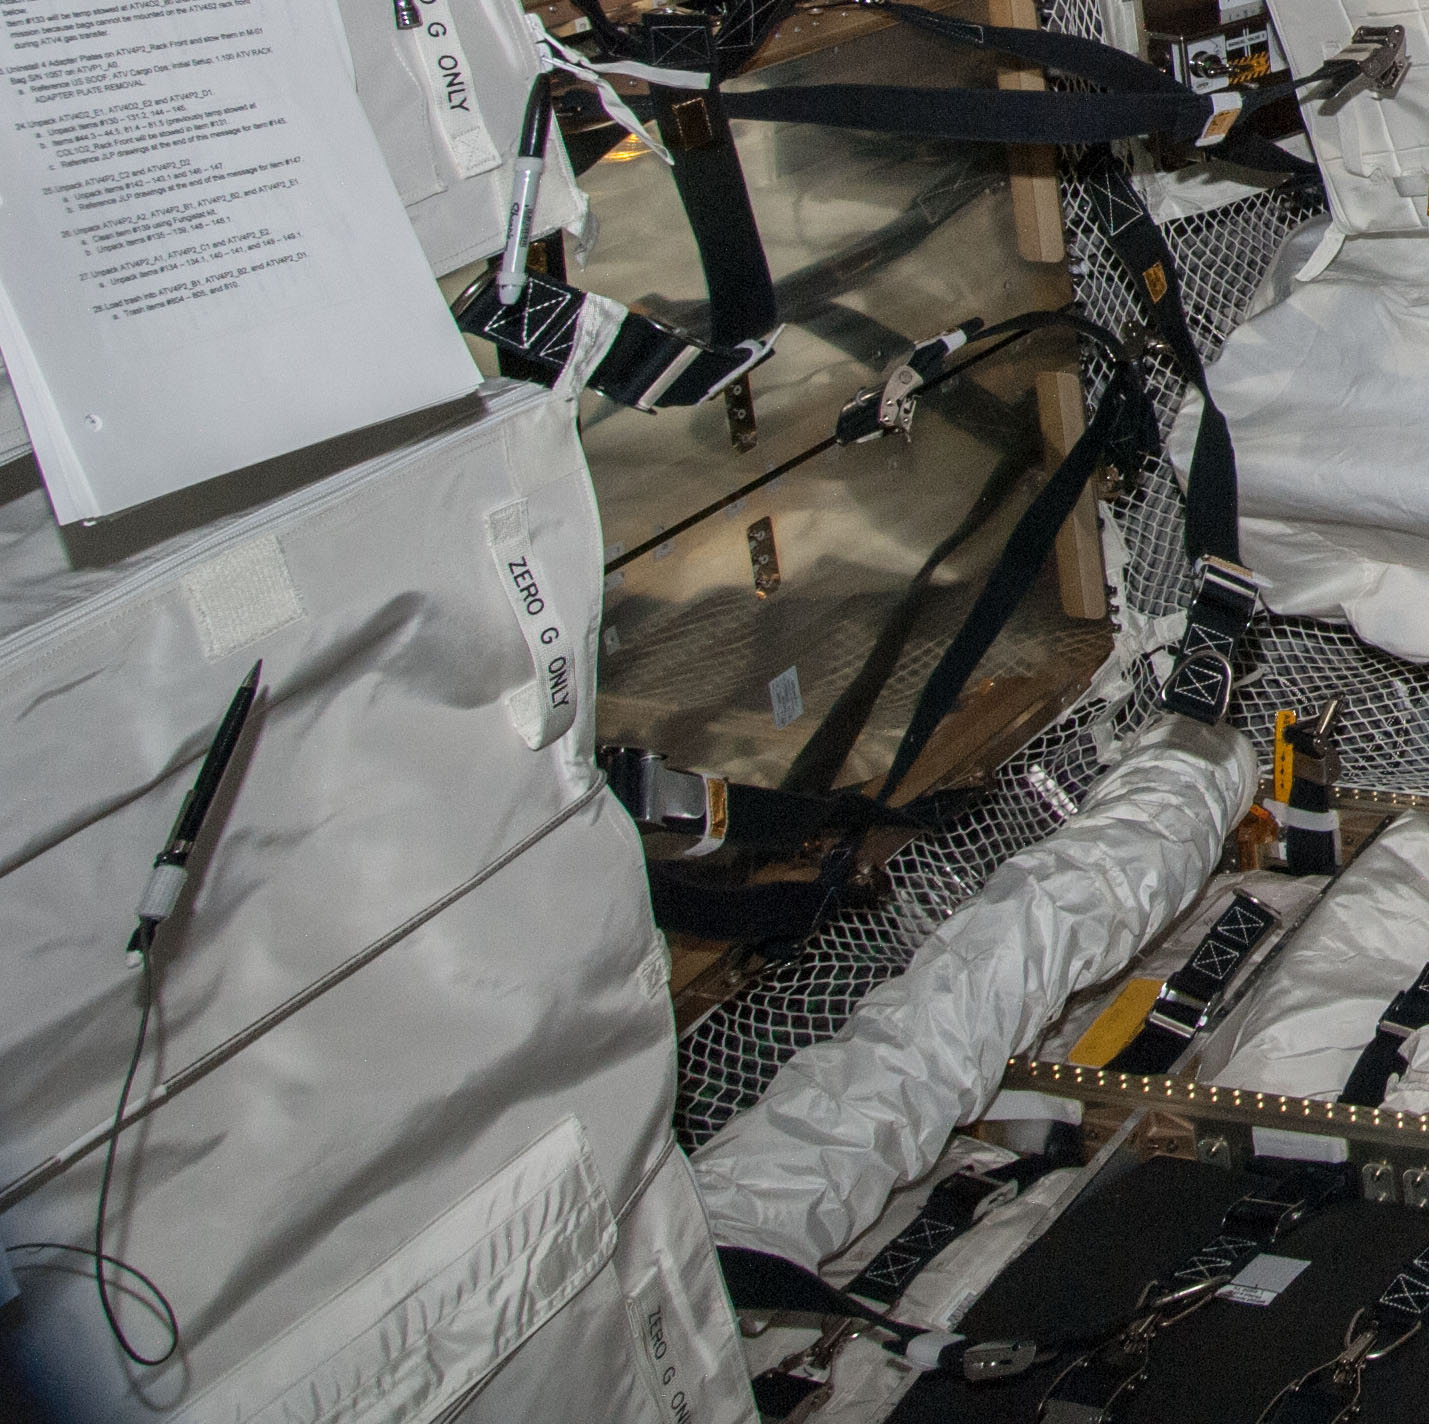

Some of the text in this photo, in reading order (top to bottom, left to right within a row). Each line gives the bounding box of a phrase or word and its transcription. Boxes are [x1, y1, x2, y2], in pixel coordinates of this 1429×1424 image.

[427, 22, 447, 38] G
[438, 55, 470, 112] ONLY
[508, 556, 569, 709] ZERO G ONLY
[648, 1305, 667, 1361] ZERO
[663, 1366, 676, 1386] G
